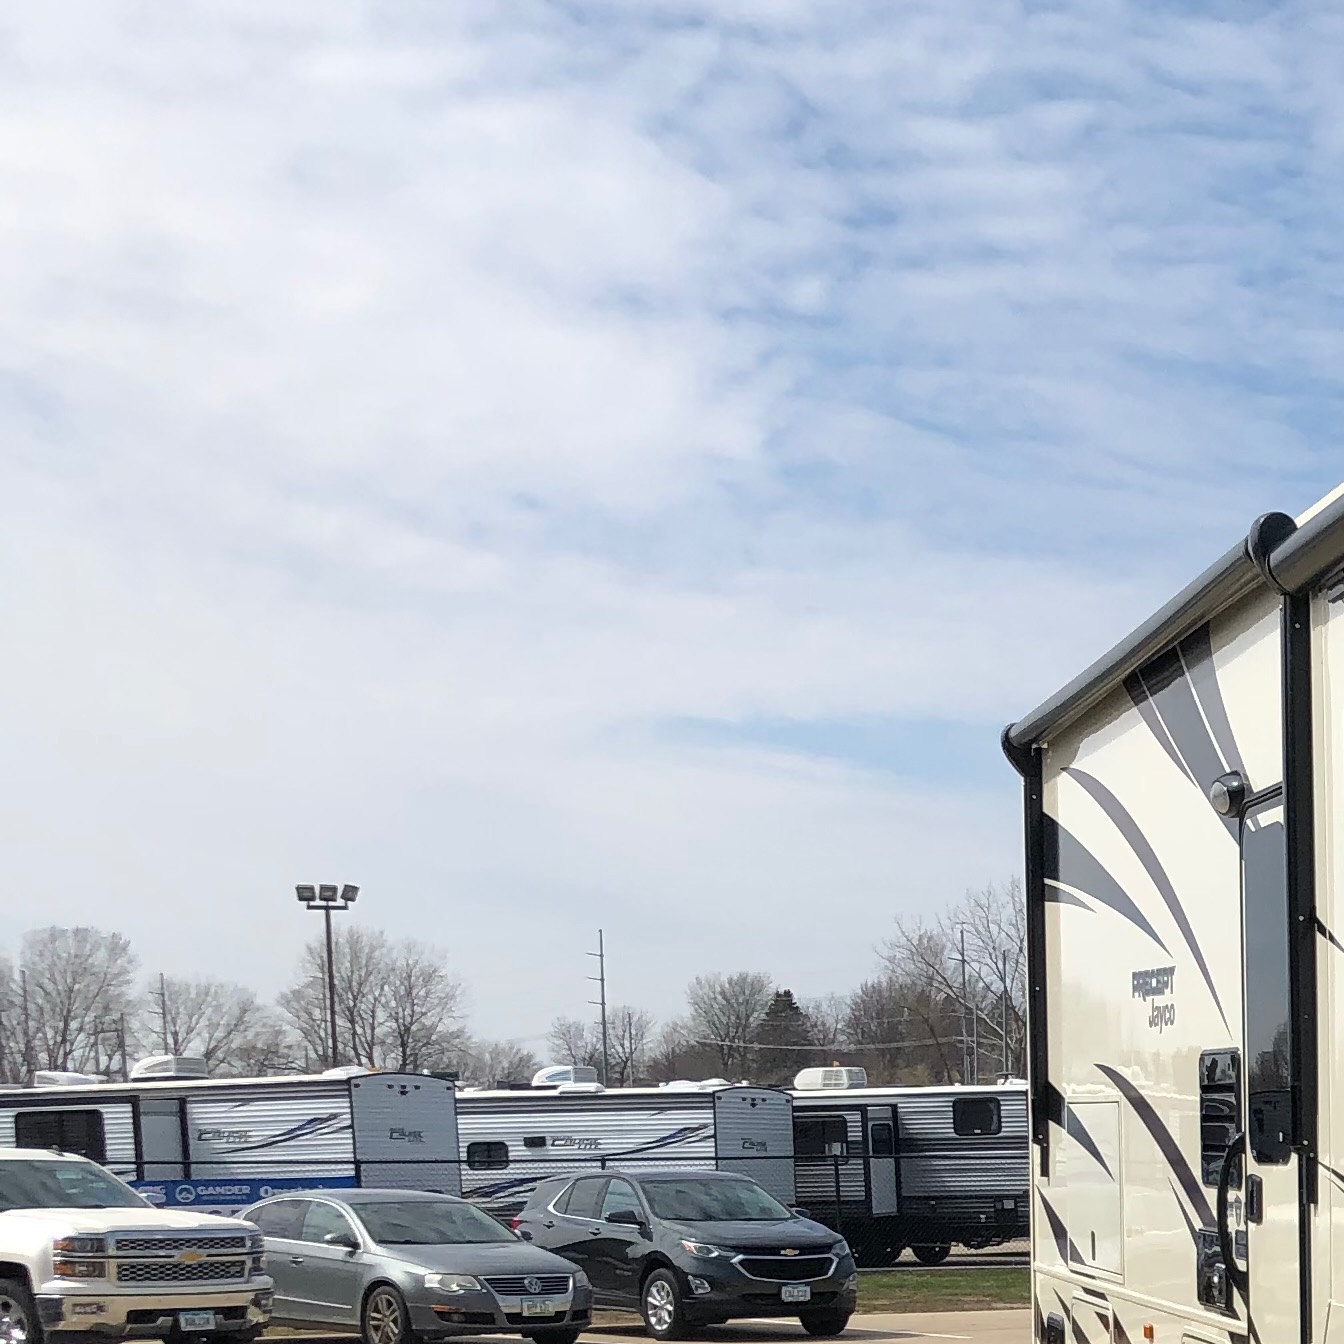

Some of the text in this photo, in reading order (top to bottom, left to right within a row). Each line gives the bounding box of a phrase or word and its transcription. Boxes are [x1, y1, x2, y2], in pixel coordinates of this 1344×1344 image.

[1131, 965, 1177, 1002] PRECEPT
[1148, 998, 1176, 1034] Jayco
[197, 1185, 251, 1195] GANDER
